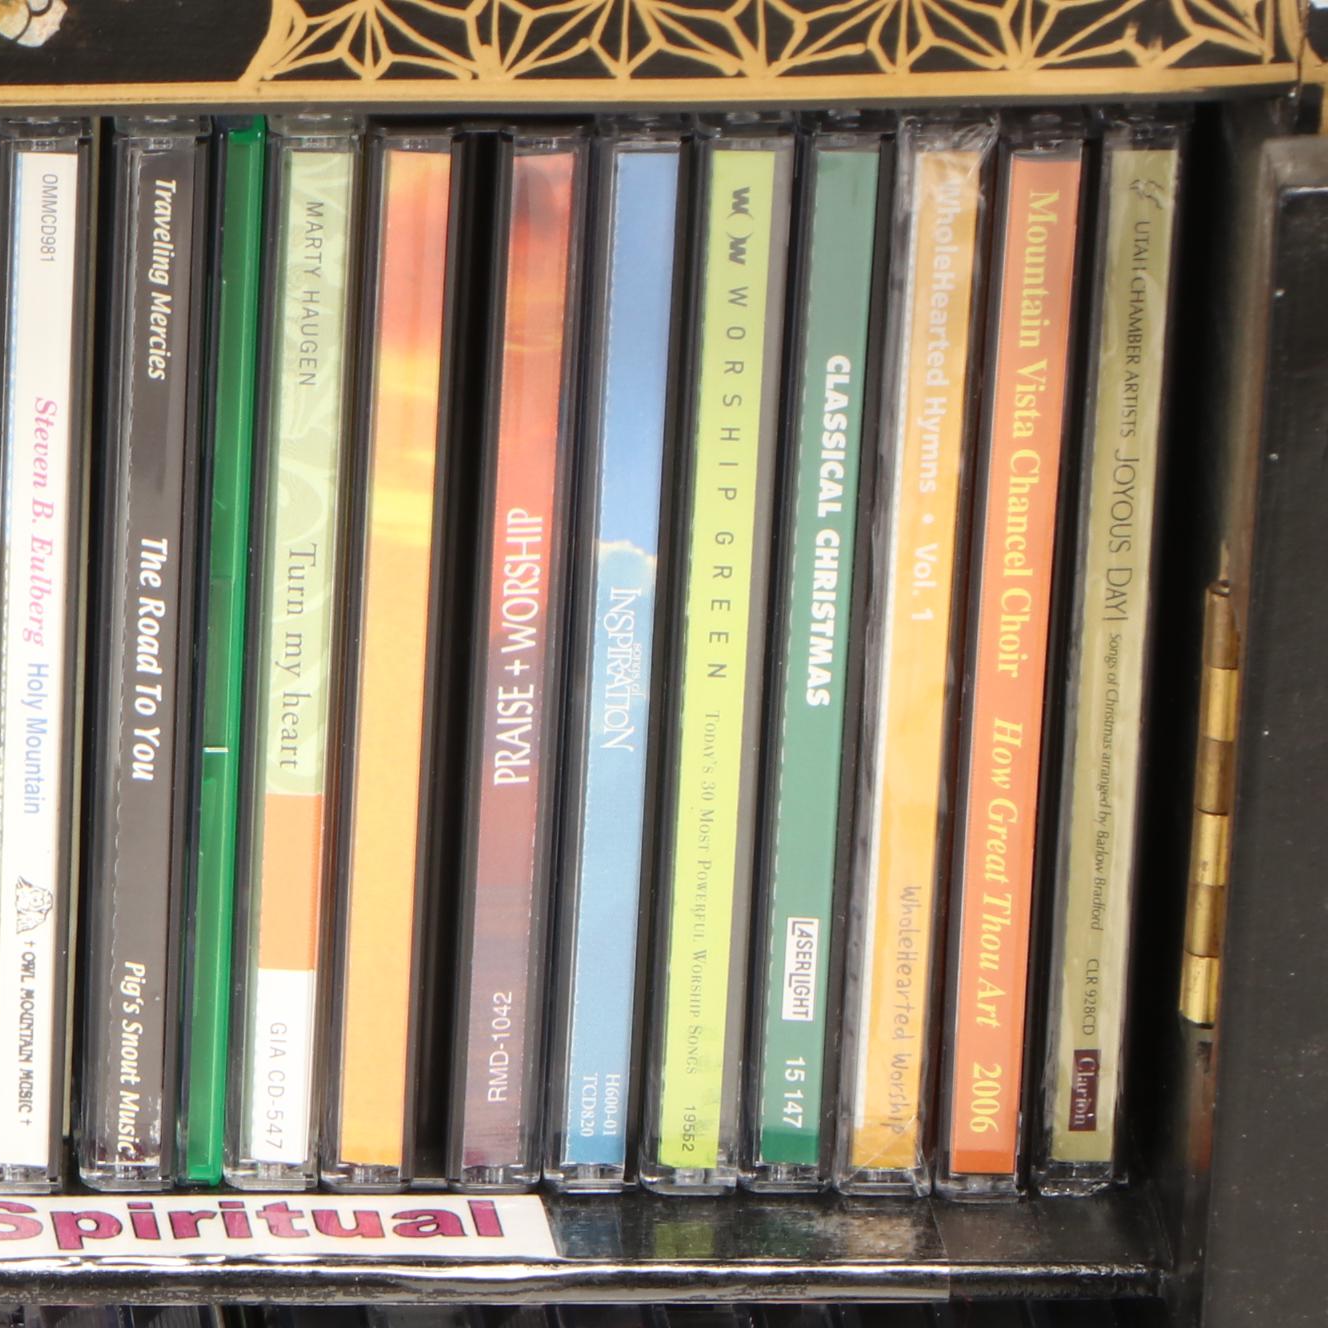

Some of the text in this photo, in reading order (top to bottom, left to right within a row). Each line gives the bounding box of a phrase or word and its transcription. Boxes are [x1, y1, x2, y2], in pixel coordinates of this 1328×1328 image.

[300, 201, 325, 386] MARTY HAUGEN
[118, 179, 176, 1154] Traveling Mercies The Road To You Pig's Snout Music
[494, 507, 542, 785] PRAISE WORSHIP
[783, 355, 851, 1128] CLASSICAL CHRISTMAS 15 147
[970, 190, 1060, 1133] Mountain Vista Chancel Choir How Great Thou Art 2006
[487, 991, 512, 1101] RMD-1042
